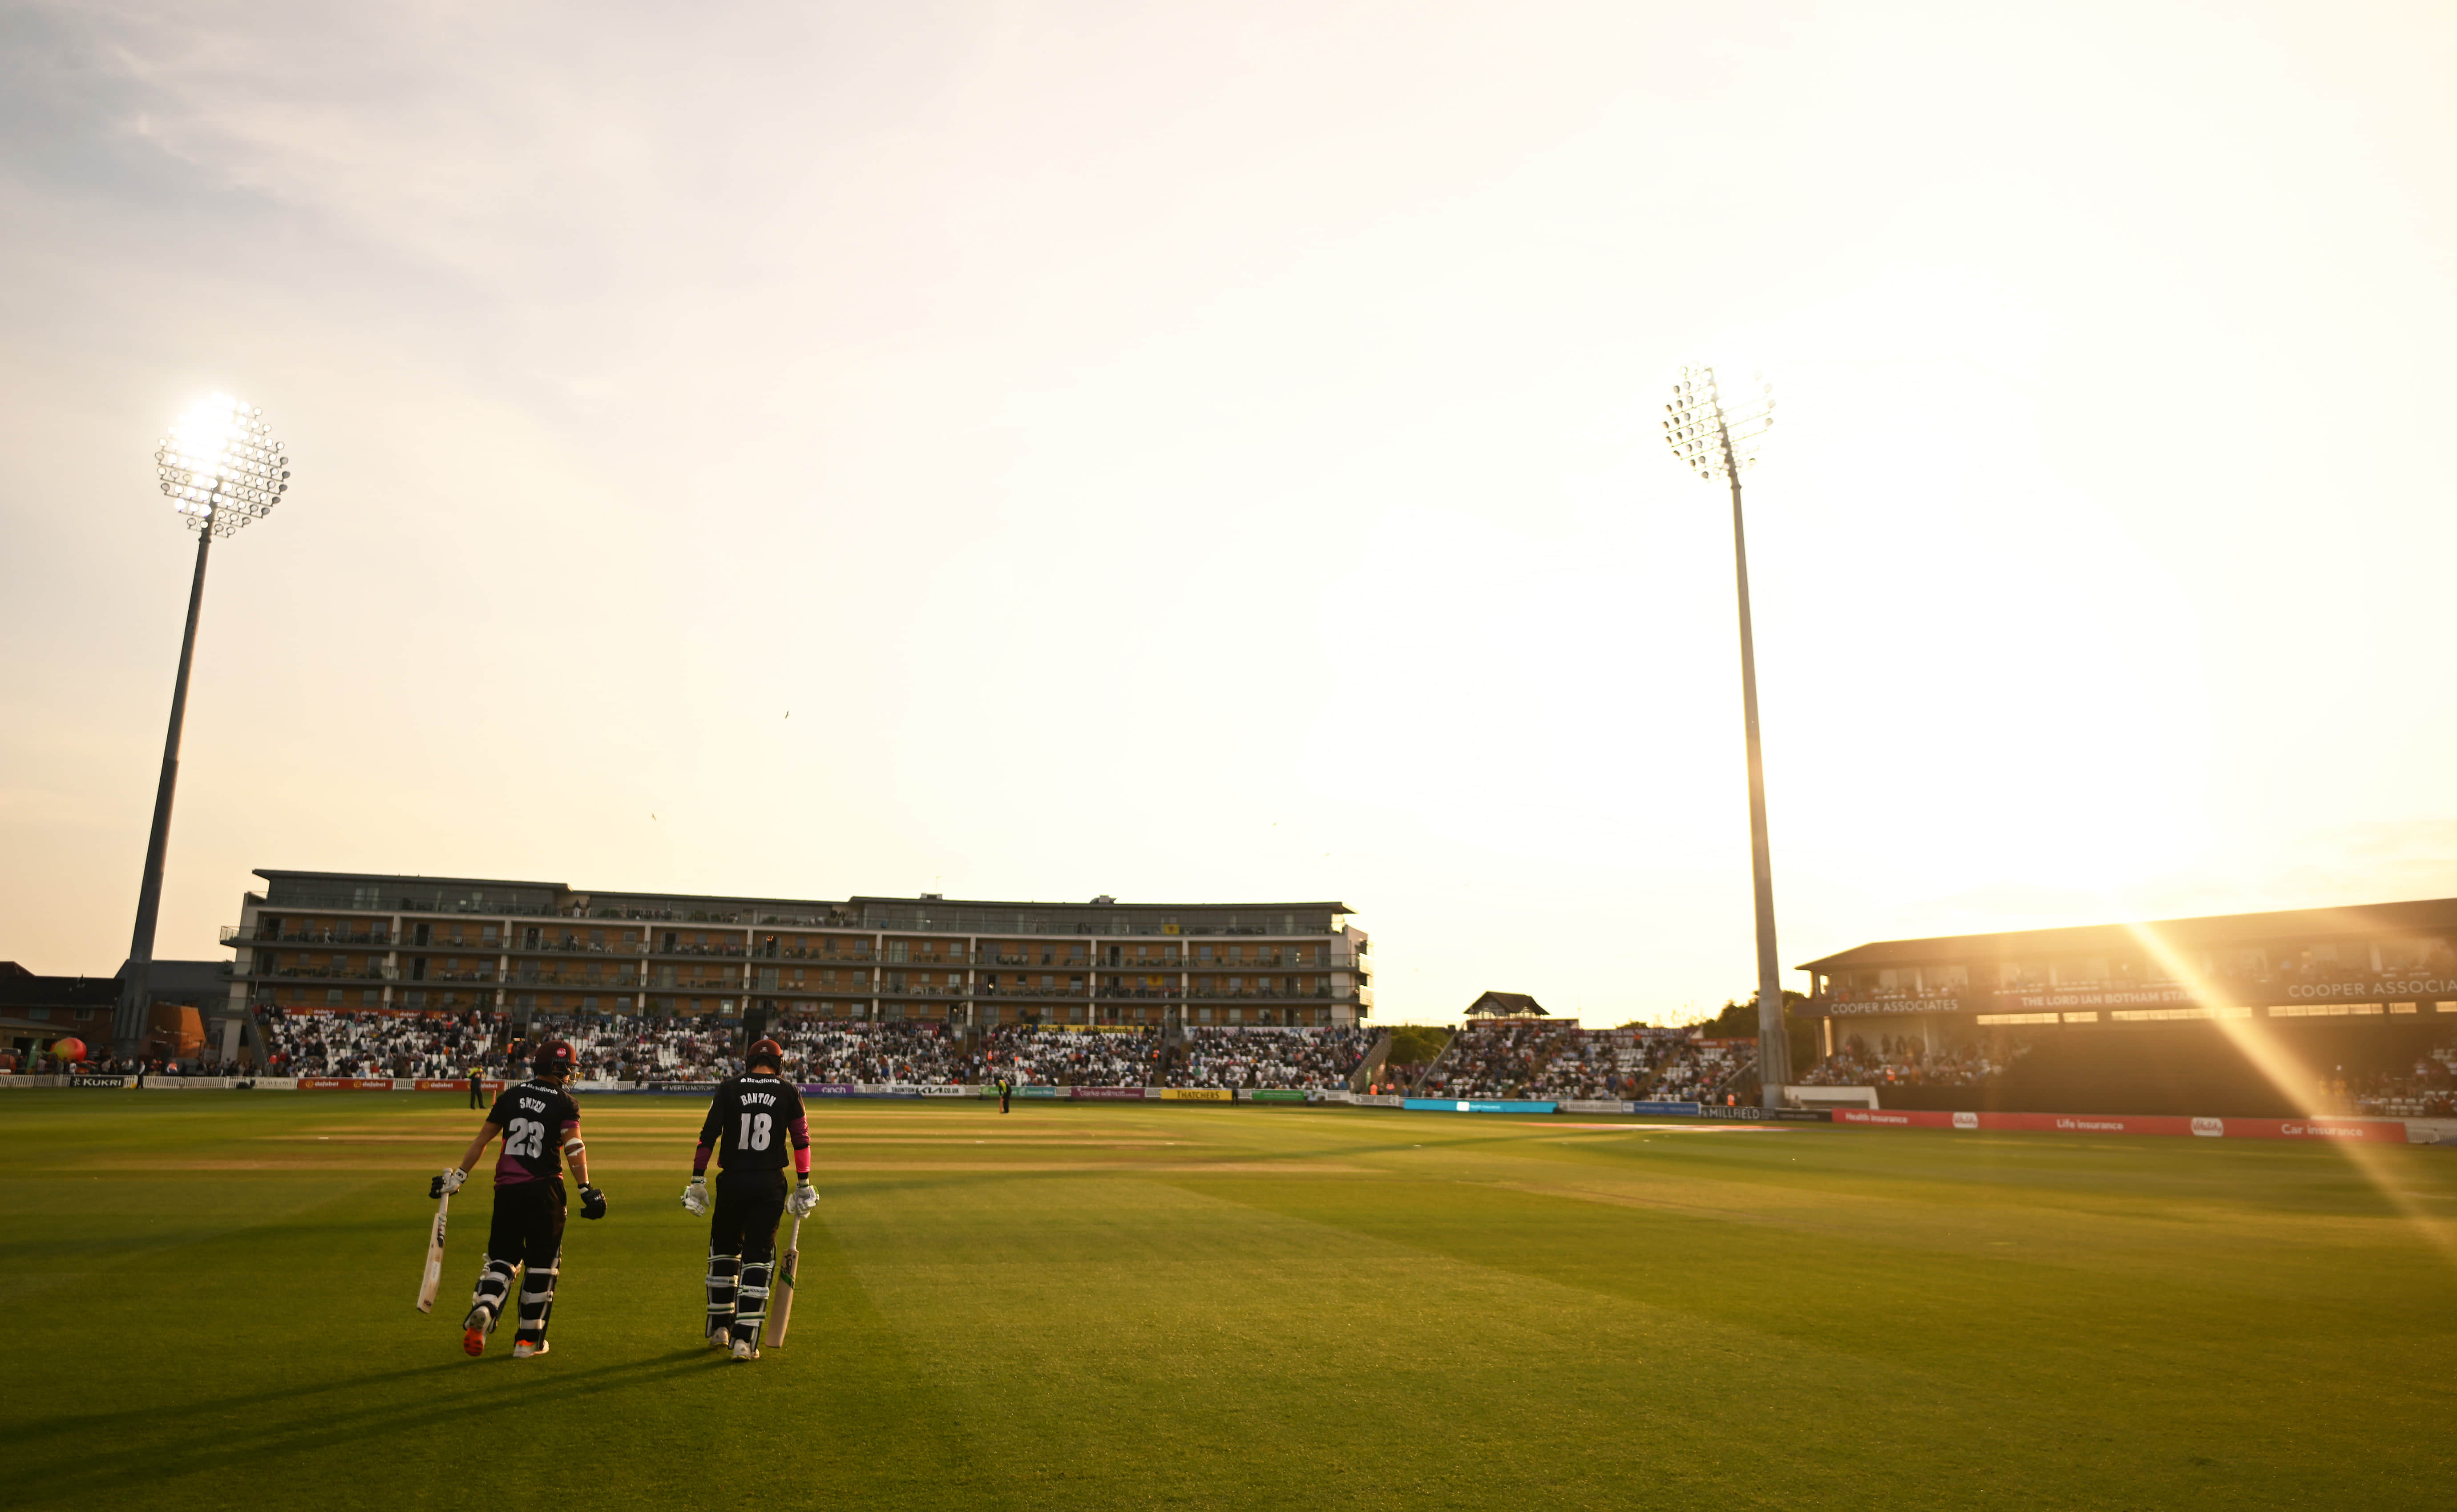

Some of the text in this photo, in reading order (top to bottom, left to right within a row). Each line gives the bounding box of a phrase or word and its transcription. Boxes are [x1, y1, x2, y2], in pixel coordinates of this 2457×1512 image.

[2288, 983, 2365, 998] COOPER
[1831, 999, 1958, 1014] COOPER ASSOCIATES
[2022, 997, 2044, 1006] THE
[2047, 996, 2077, 1006] LORD
[2081, 995, 2102, 1004] IAN
[2105, 994, 2158, 1004] BOTHAM
[83, 1078, 121, 1086] KUKRI
[740, 1092, 776, 1107] BANTON
[1176, 1091, 1220, 1099] THATCHERS
[519, 1097, 546, 1113] SMEED
[1709, 1108, 1760, 1120] MILLFIELD
[1846, 1113, 1908, 1124] Health insurance
[2057, 1119, 2124, 1130] Life insurance
[2281, 1124, 2364, 1137] Car insurance
[505, 1117, 545, 1158] 23
[738, 1112, 772, 1151] 18
